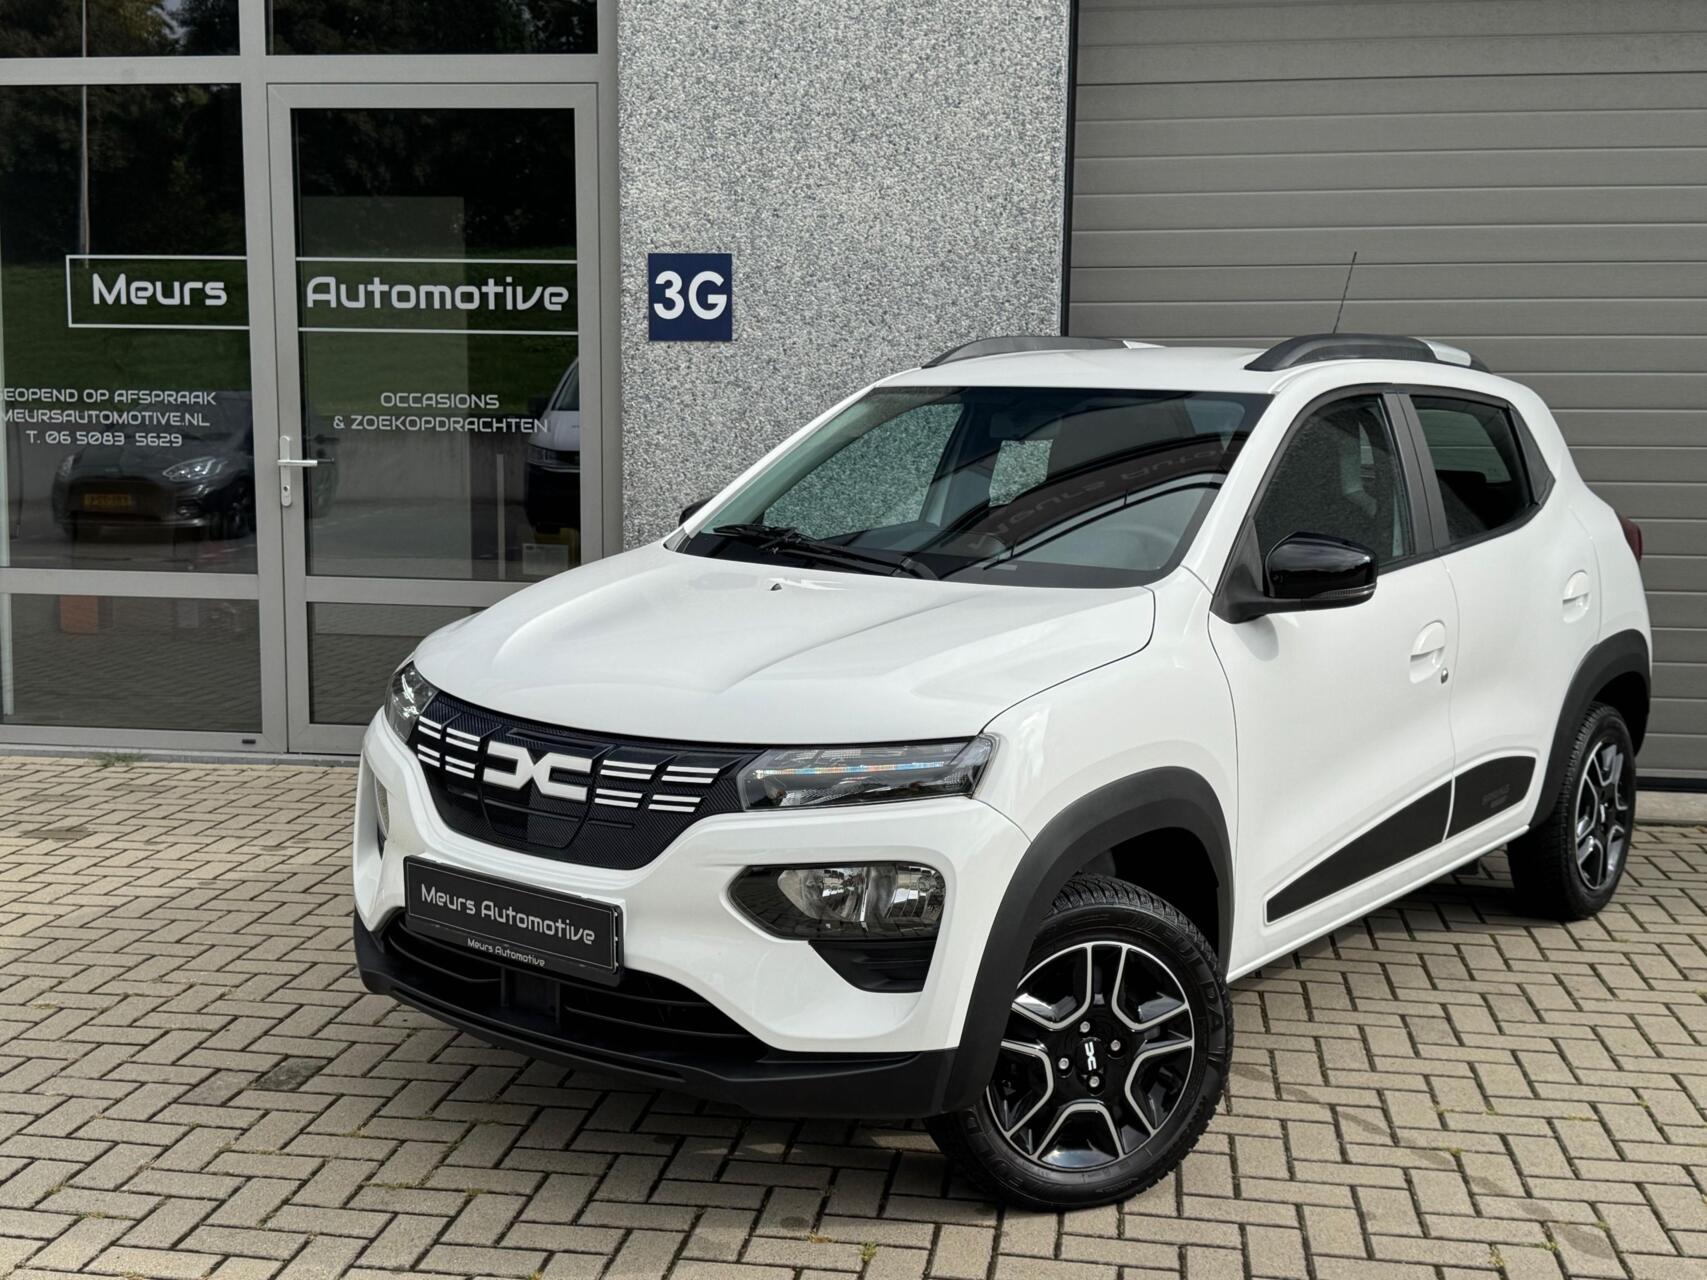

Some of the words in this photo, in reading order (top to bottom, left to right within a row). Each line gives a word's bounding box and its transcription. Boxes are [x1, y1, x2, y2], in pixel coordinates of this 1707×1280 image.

[92, 273, 228, 306] Meurs
[306, 276, 569, 311] Automotive
[653, 270, 728, 320] 3G
[0, 388, 78, 403] EOPEND
[83, 389, 110, 404] OP
[114, 390, 217, 406] AFSPRAAK
[380, 392, 500, 409] OCCASIONS
[332, 415, 346, 431] &
[350, 414, 549, 434] ZOEKOPDRACHTEN
[25, 431, 41, 445] T.
[45, 431, 72, 446] 06
[75, 432, 126, 446] 5083
[135, 433, 183, 447] 5629
[421, 884, 476, 915] Meurs
[481, 901, 596, 946] Automotive
[467, 937, 494, 953] Meurs
[495, 945, 546, 968] Automotive
